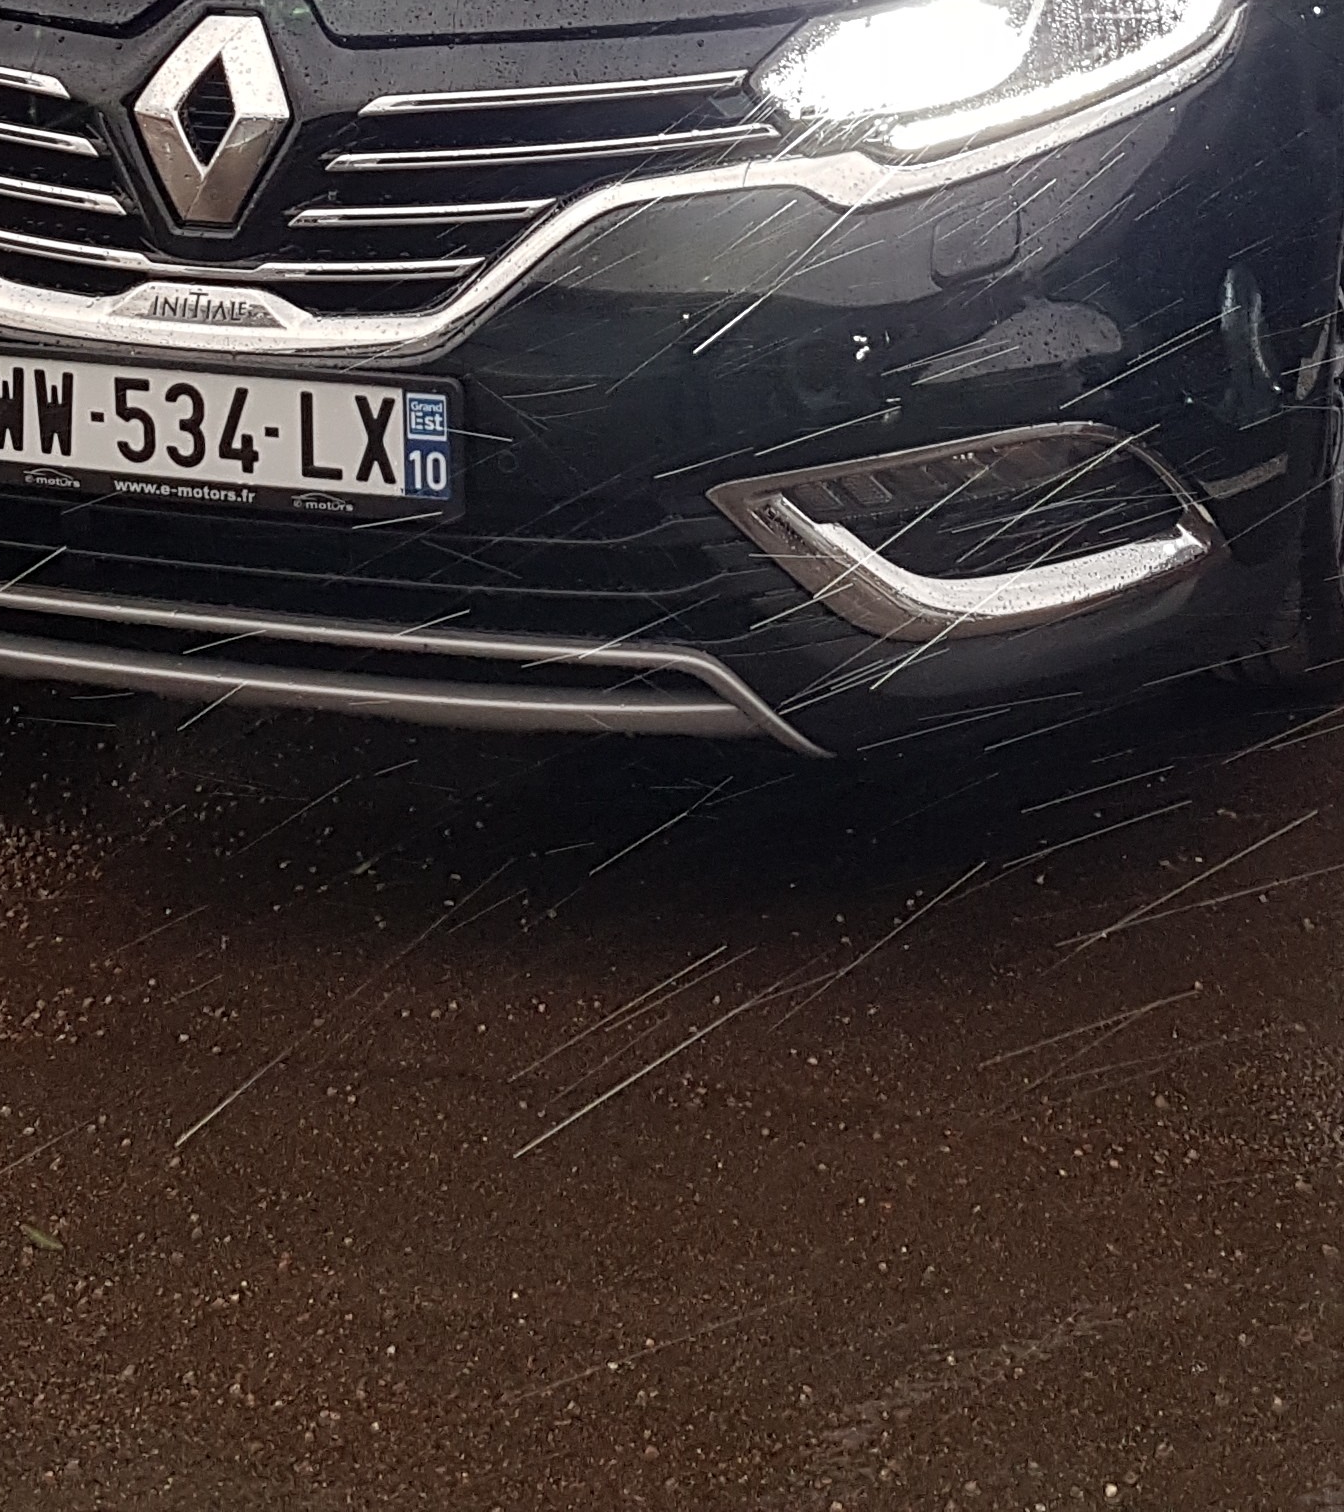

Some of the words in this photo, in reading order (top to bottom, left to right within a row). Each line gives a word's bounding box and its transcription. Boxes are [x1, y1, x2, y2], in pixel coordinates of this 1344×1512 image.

[152, 289, 248, 321] INITIALE
[410, 400, 443, 412] Grand
[410, 411, 444, 431] Est
[409, 449, 447, 491] 10
[114, 477, 256, 504] www.e-motors.fr
